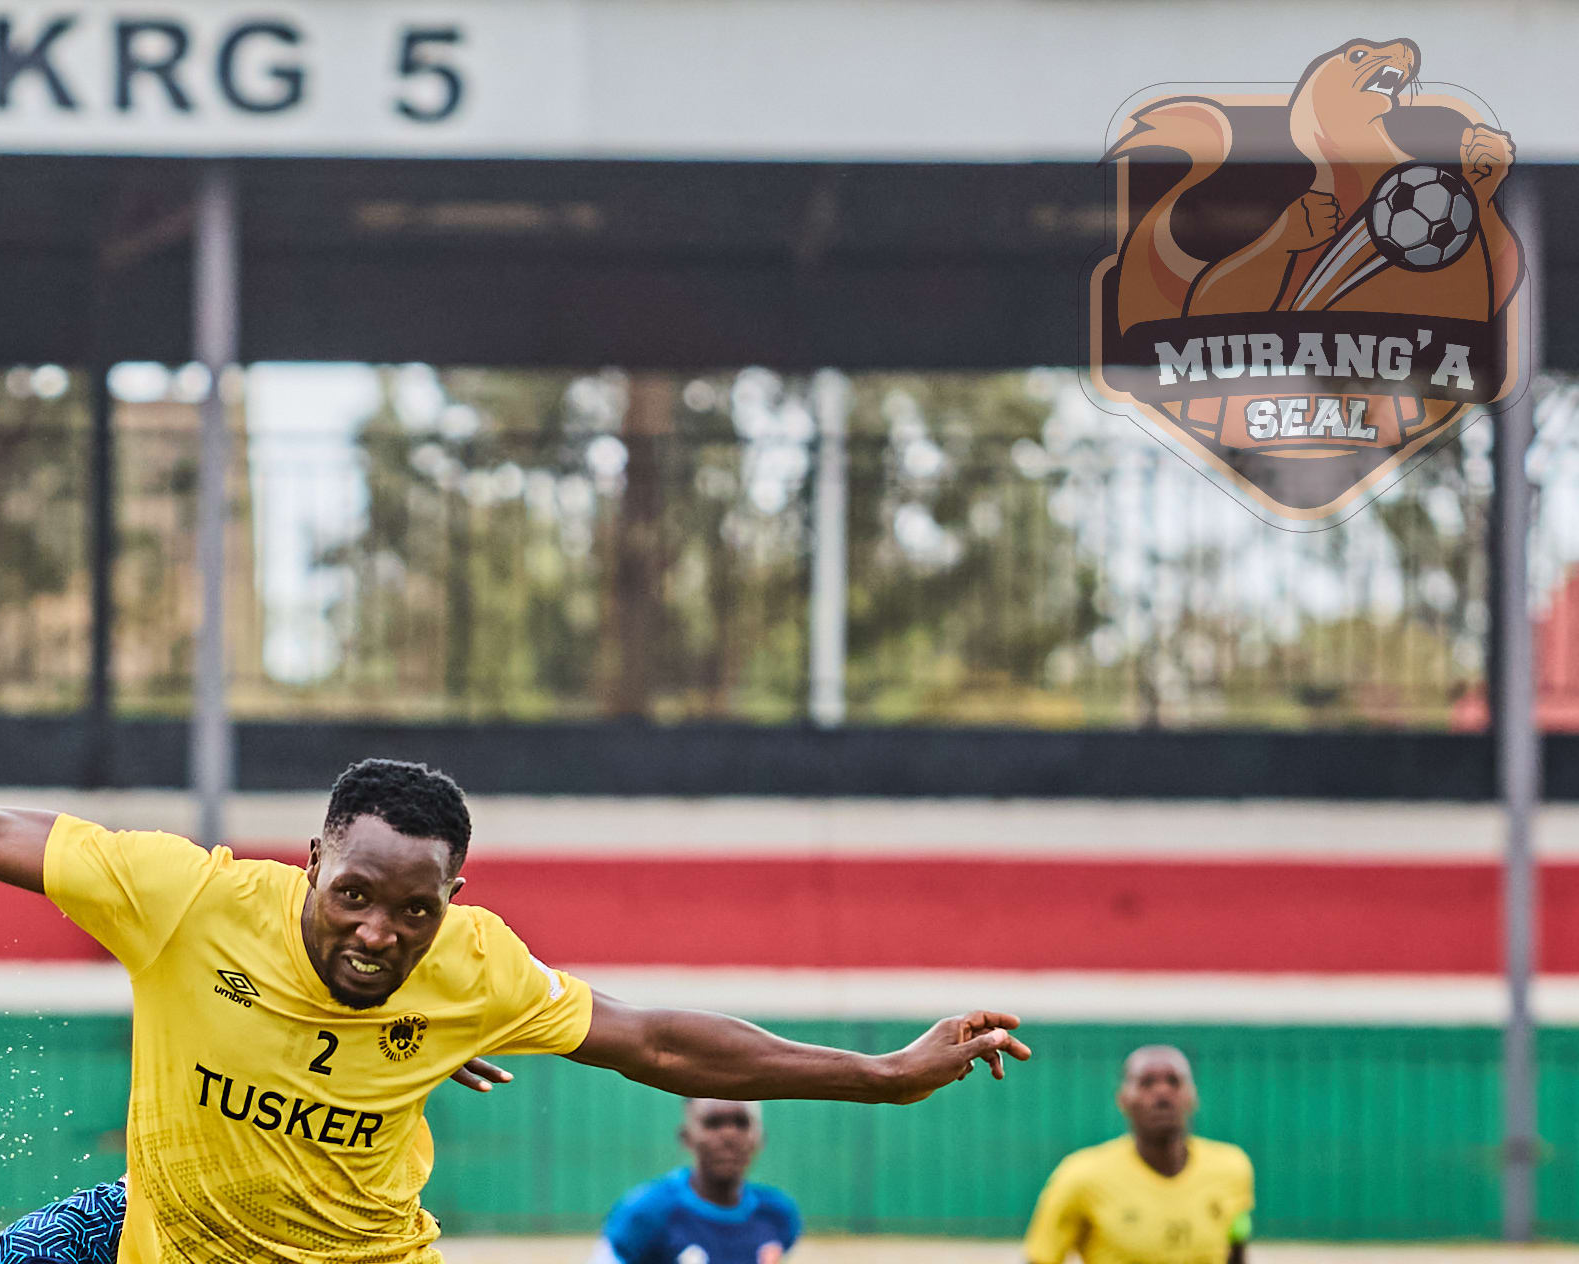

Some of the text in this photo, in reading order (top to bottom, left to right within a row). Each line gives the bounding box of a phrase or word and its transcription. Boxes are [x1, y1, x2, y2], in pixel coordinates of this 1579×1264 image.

[394, 29, 463, 123] 5
[214, 984, 252, 1008] umbro
[308, 1030, 339, 1076] 2
[194, 1061, 384, 1148] TUSKER
